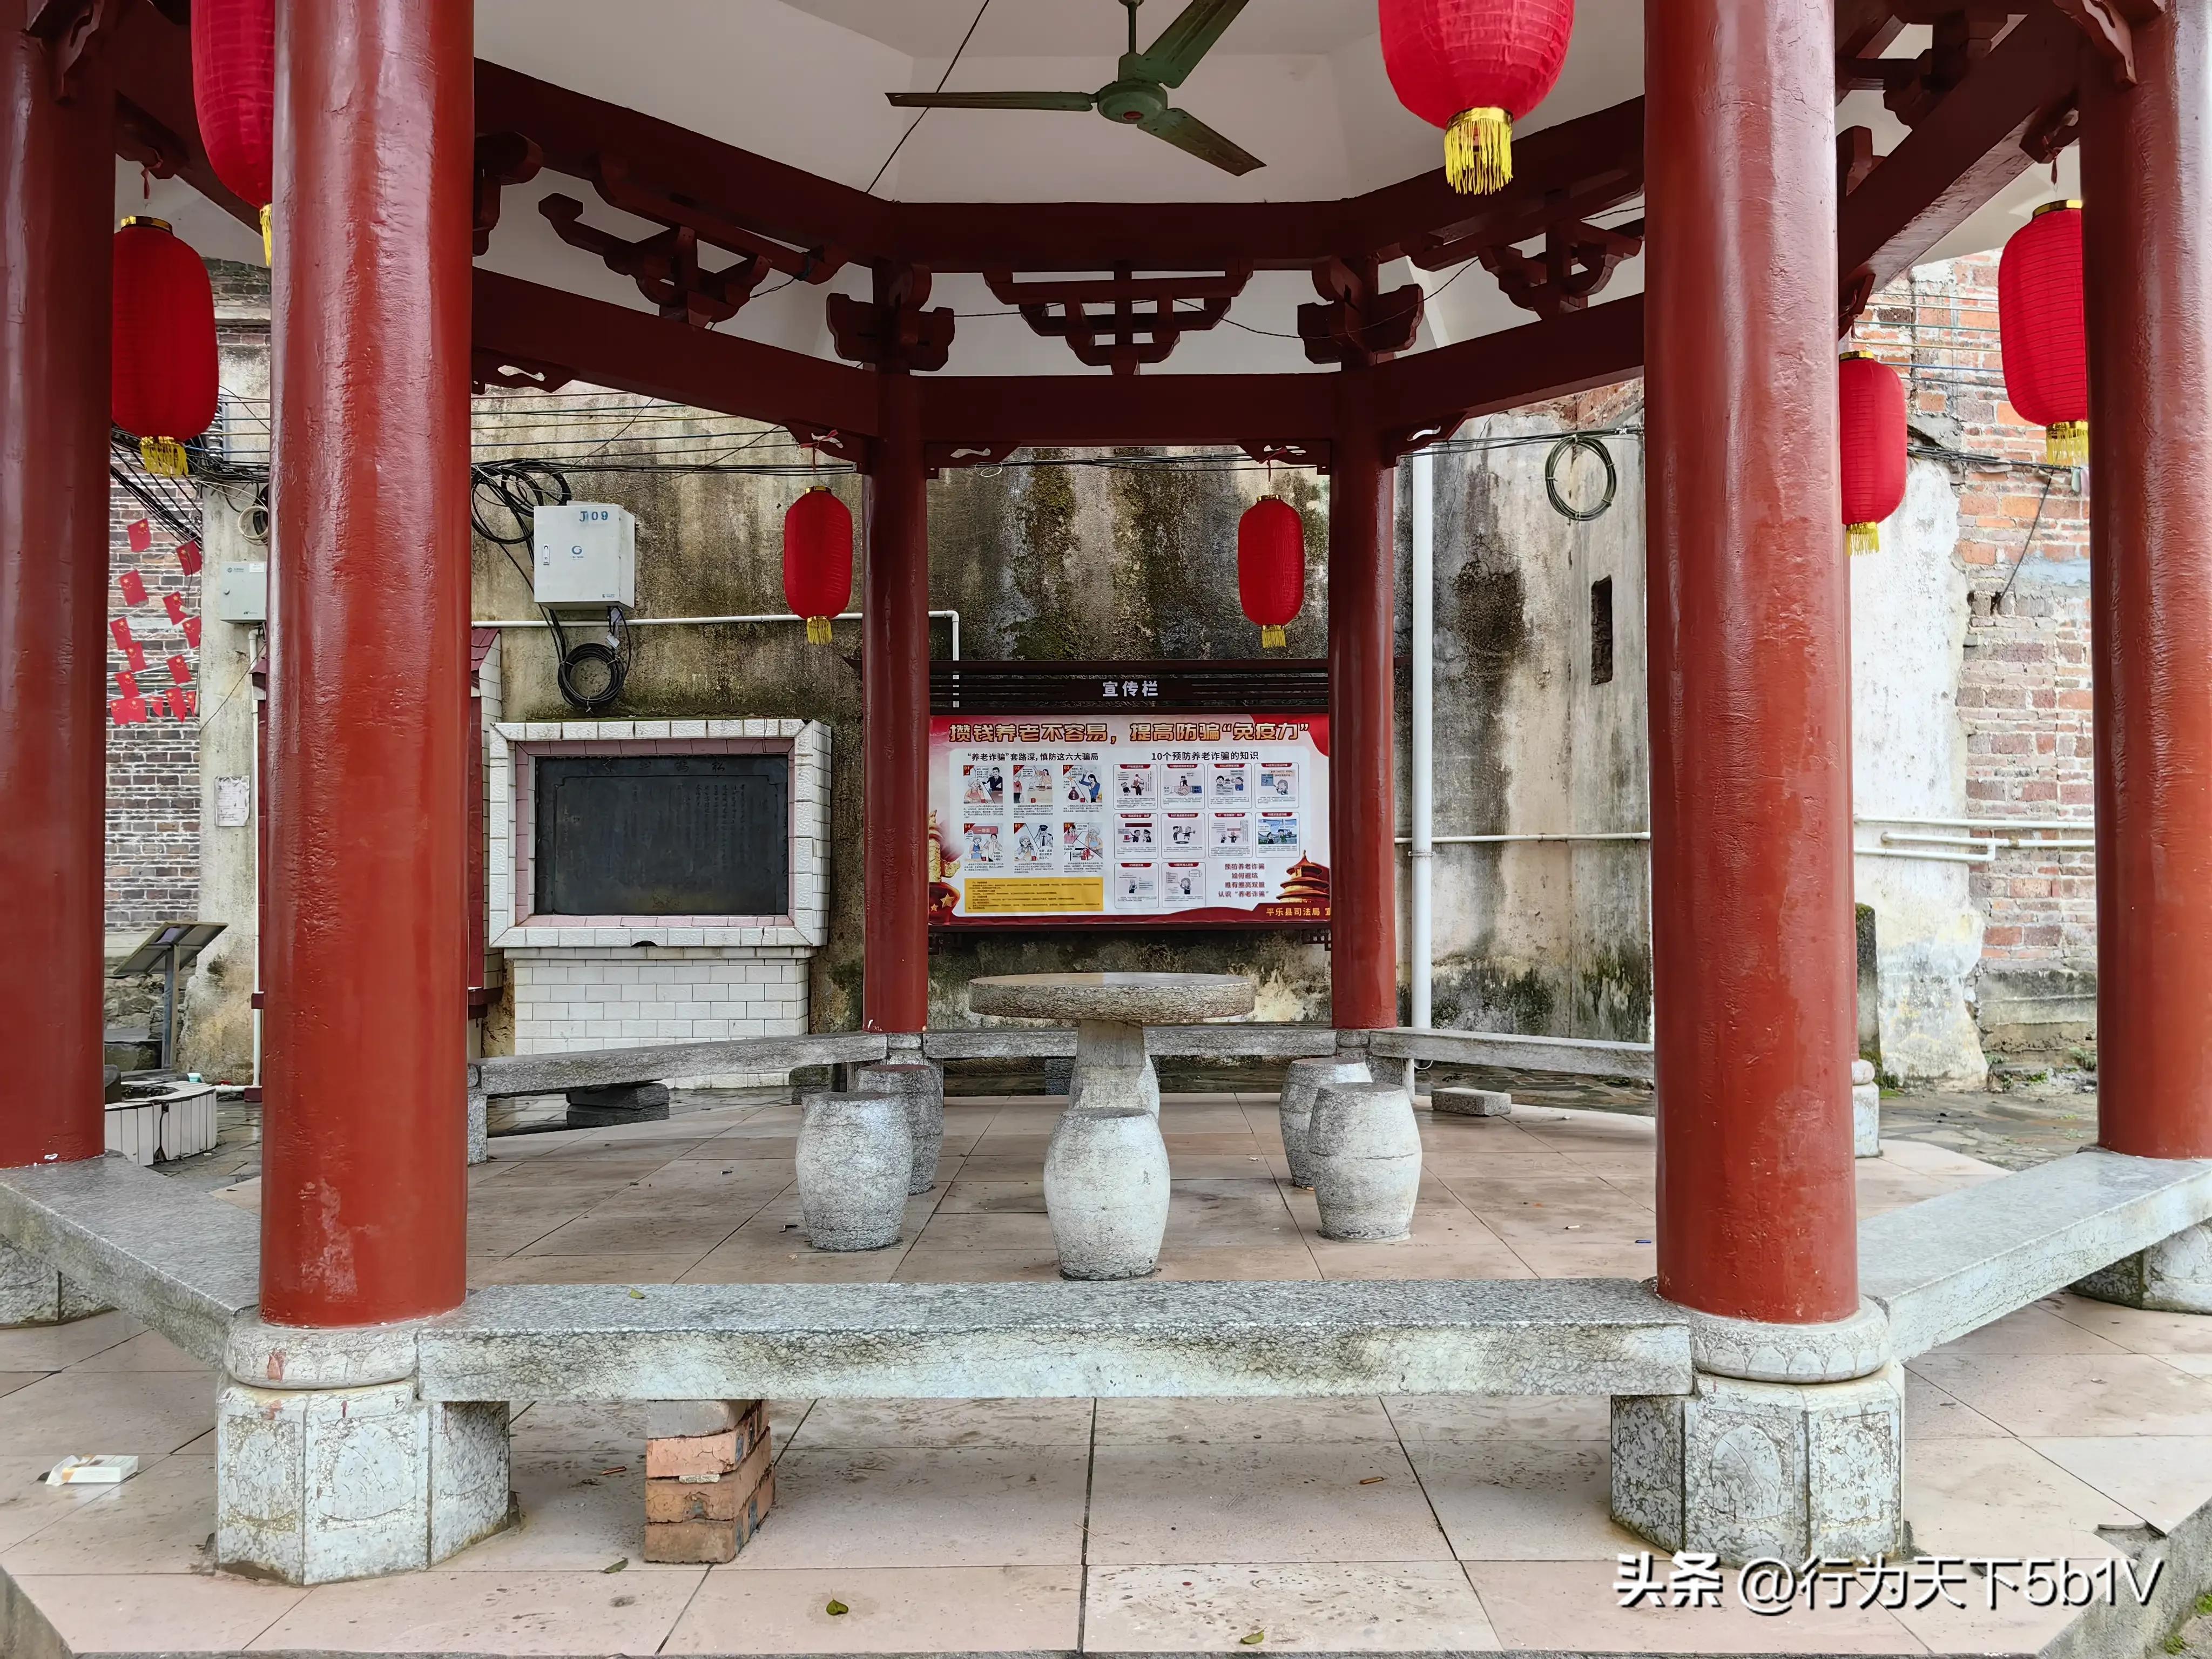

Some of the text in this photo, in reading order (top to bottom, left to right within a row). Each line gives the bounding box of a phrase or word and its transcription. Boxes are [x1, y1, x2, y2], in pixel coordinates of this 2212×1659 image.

[1103, 680, 1158, 697] 宣传栏
[1151, 751, 1259, 761] 10个预防养老诈骗的知识
[1266, 907, 1320, 916] 平乐县司法局
